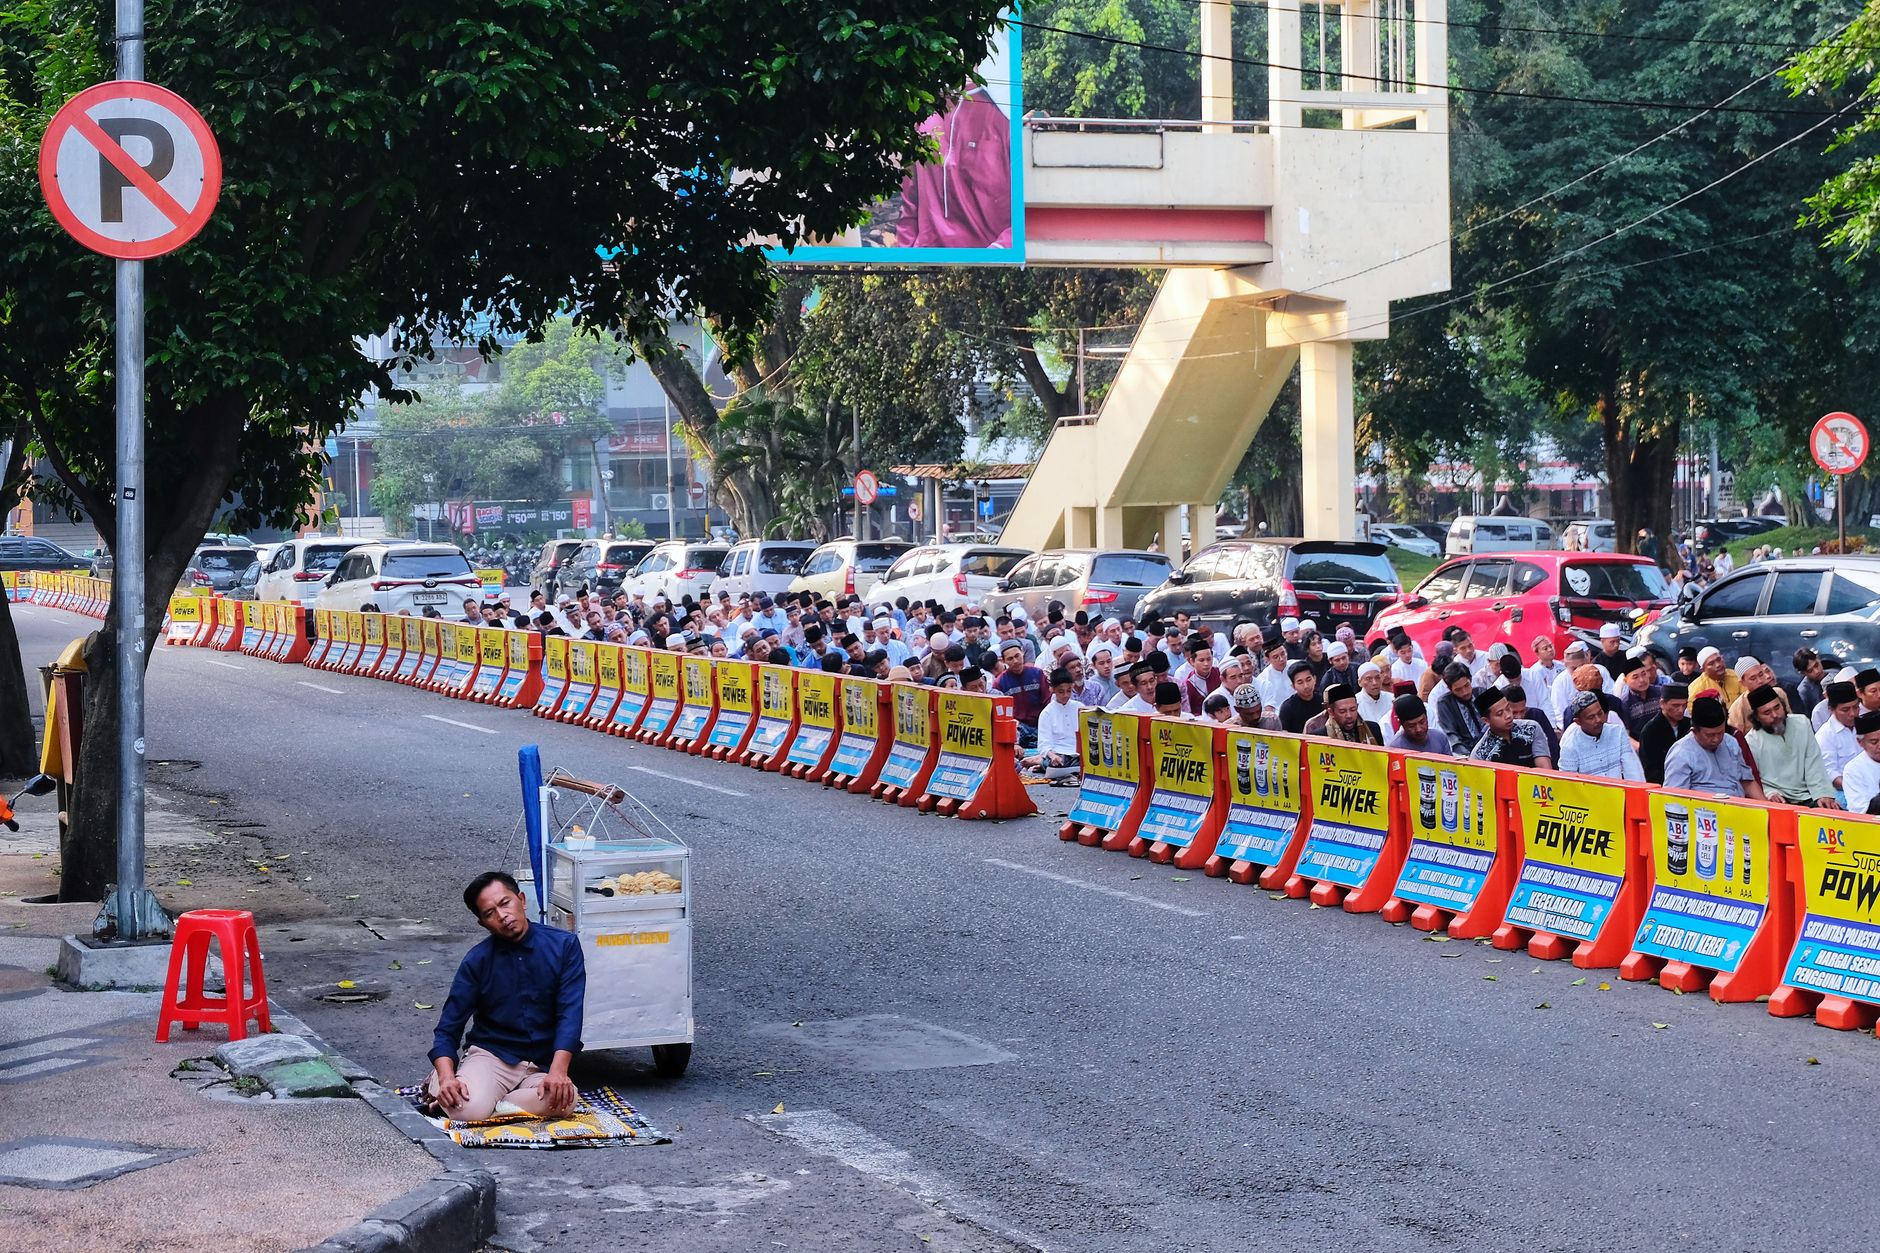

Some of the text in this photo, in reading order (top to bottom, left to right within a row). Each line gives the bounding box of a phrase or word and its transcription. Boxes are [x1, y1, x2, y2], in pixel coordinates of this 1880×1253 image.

[98, 118, 175, 222] P
[634, 435, 658, 444] FREE
[174, 608, 195, 616] POWER
[722, 687, 747, 705] POWER
[804, 699, 830, 721] POWER
[947, 724, 984, 749] POWER
[1159, 729, 1171, 742] ABC
[1164, 744, 1192, 759] Super
[1257, 749, 1268, 759] ABC
[1320, 752, 1336, 767] ABC
[1160, 757, 1208, 786] POWER
[1324, 769, 1362, 786] Super
[1420, 783, 1435, 794] ABC
[1443, 778, 1457, 790] ABC
[1320, 783, 1381, 818] POWER
[1532, 785, 1554, 801] ABC
[1540, 804, 1589, 824] Super
[1669, 821, 1687, 834] ABC
[1698, 817, 1717, 832] ABC
[1476, 839, 1485, 847] AAA
[1534, 820, 1616, 859] POWER
[1818, 828, 1845, 846] ABC
[1701, 844, 1711, 852] DRY
[1701, 852, 1711, 860] CELL
[1346, 858, 1360, 872] SNI
[1522, 865, 1617, 898] SATLANTAS POLRESTA MALANG KOTA
[1724, 886, 1732, 894] AA
[1740, 889, 1752, 898] AAA
[1819, 868, 1880, 914] POW
[1528, 891, 1586, 918] KECELAKAAN
[1653, 891, 1759, 927] SATLANTAS POLRESTA MALANG KOTA
[1544, 913, 1594, 937] PELANGGARAN
[1804, 921, 1846, 944] SATLANTAS
[1652, 924, 1728, 958] TERTIB ITU KEREN
[1814, 949, 1853, 970] HARGAI
[1793, 966, 1843, 991] PENGGUNA
[1841, 976, 1871, 996] JALAN
